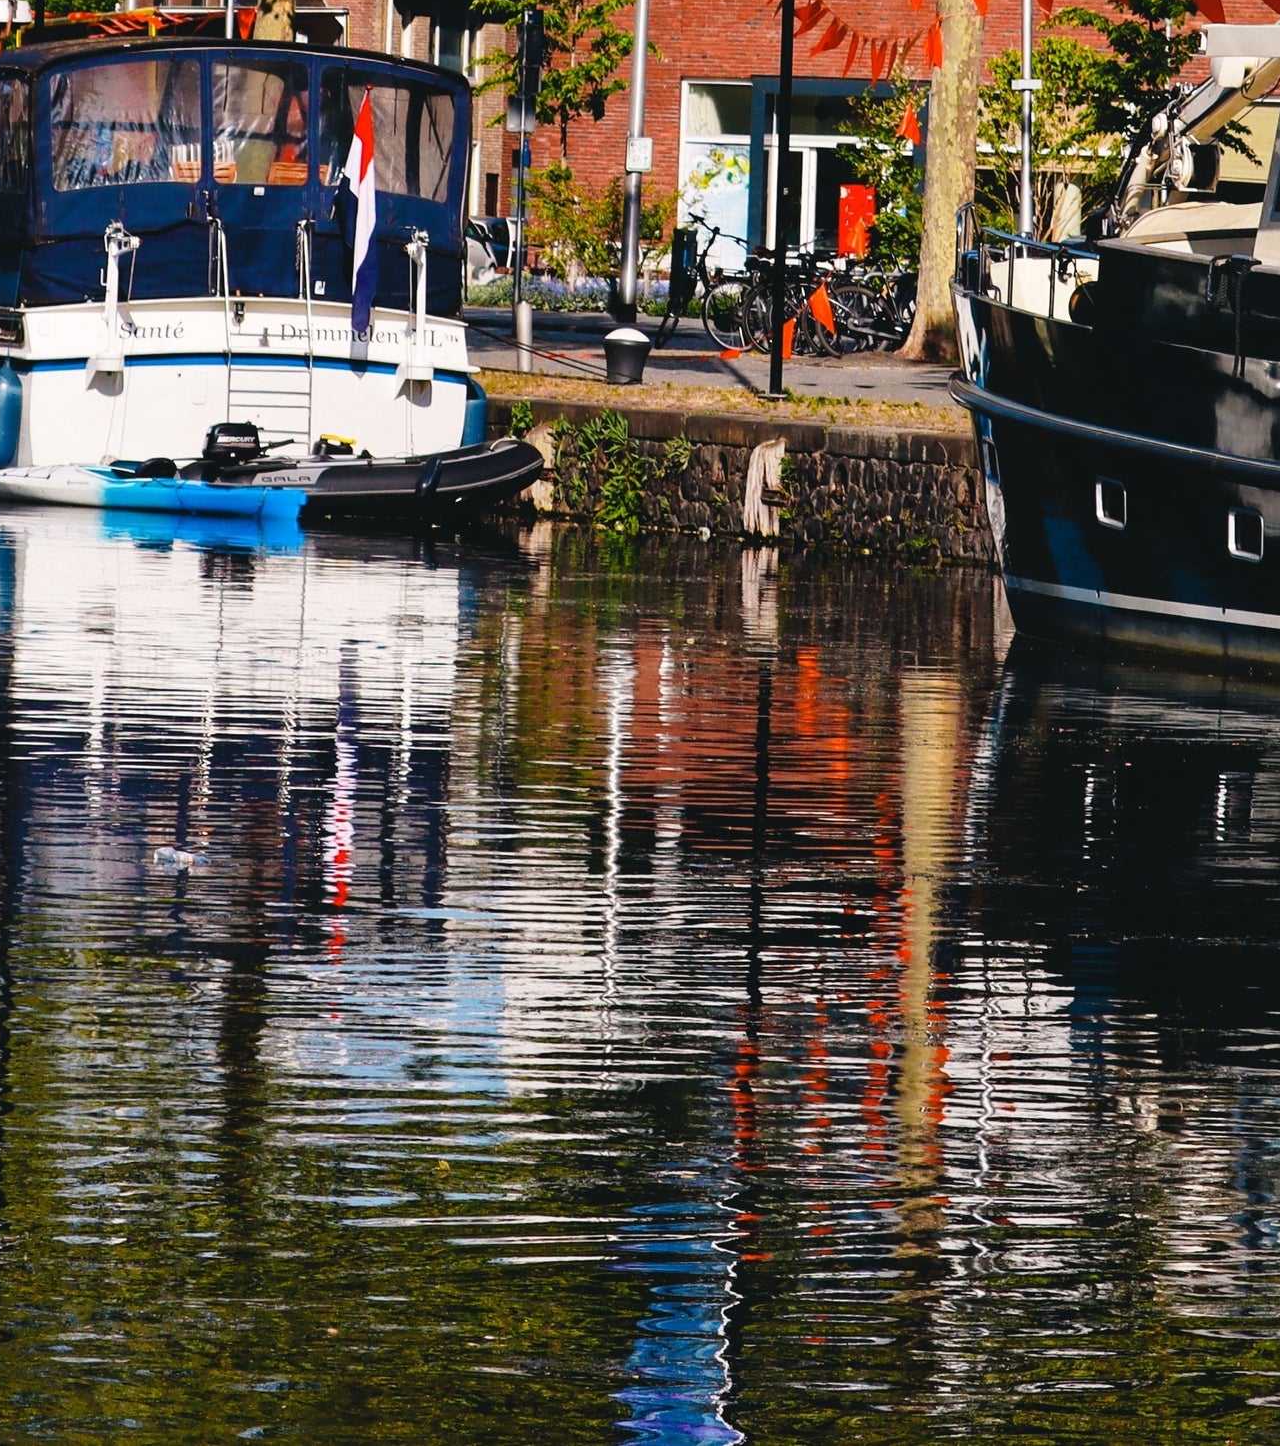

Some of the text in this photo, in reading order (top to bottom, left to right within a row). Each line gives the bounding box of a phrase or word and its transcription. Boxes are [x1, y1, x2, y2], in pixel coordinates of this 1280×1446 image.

[119, 321, 185, 340] Santé
[216, 435, 256, 443] MERCURY
[261, 475, 312, 483] GALA
